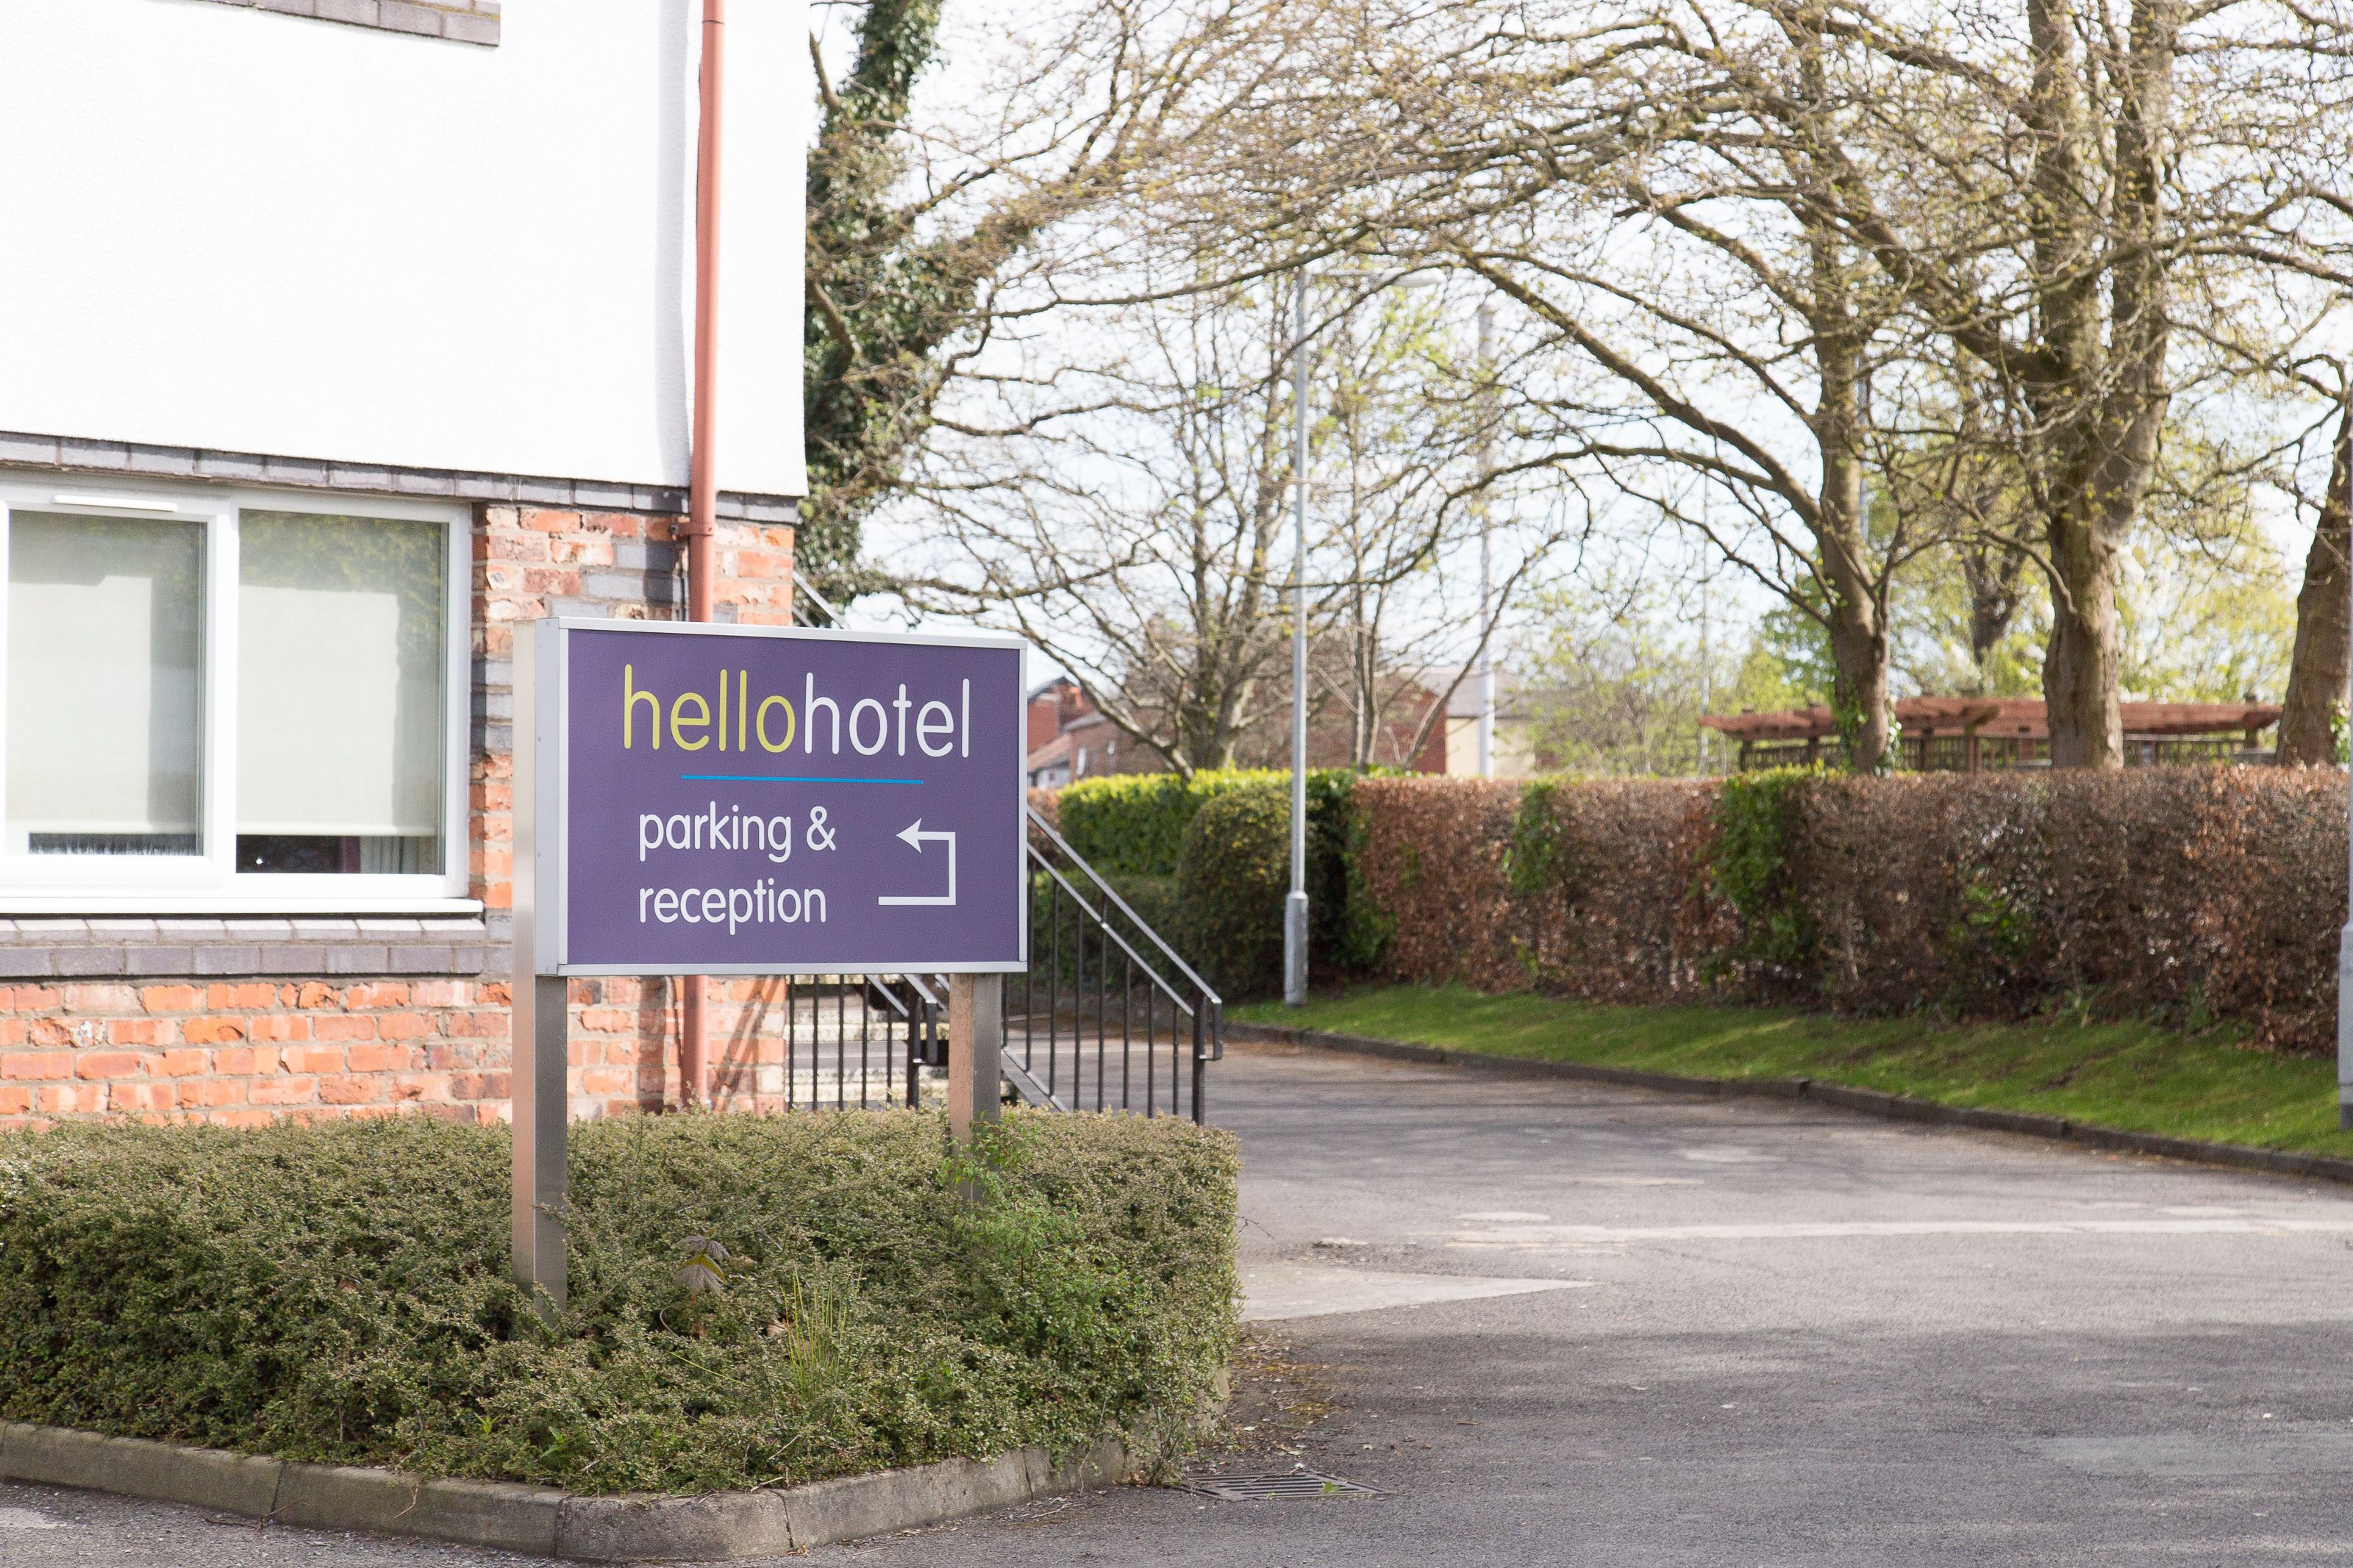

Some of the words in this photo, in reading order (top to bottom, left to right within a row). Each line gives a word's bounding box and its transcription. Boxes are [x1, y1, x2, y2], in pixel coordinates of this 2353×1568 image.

[640, 801, 791, 862] parking
[807, 806, 835, 851] &
[640, 878, 826, 935] reception
